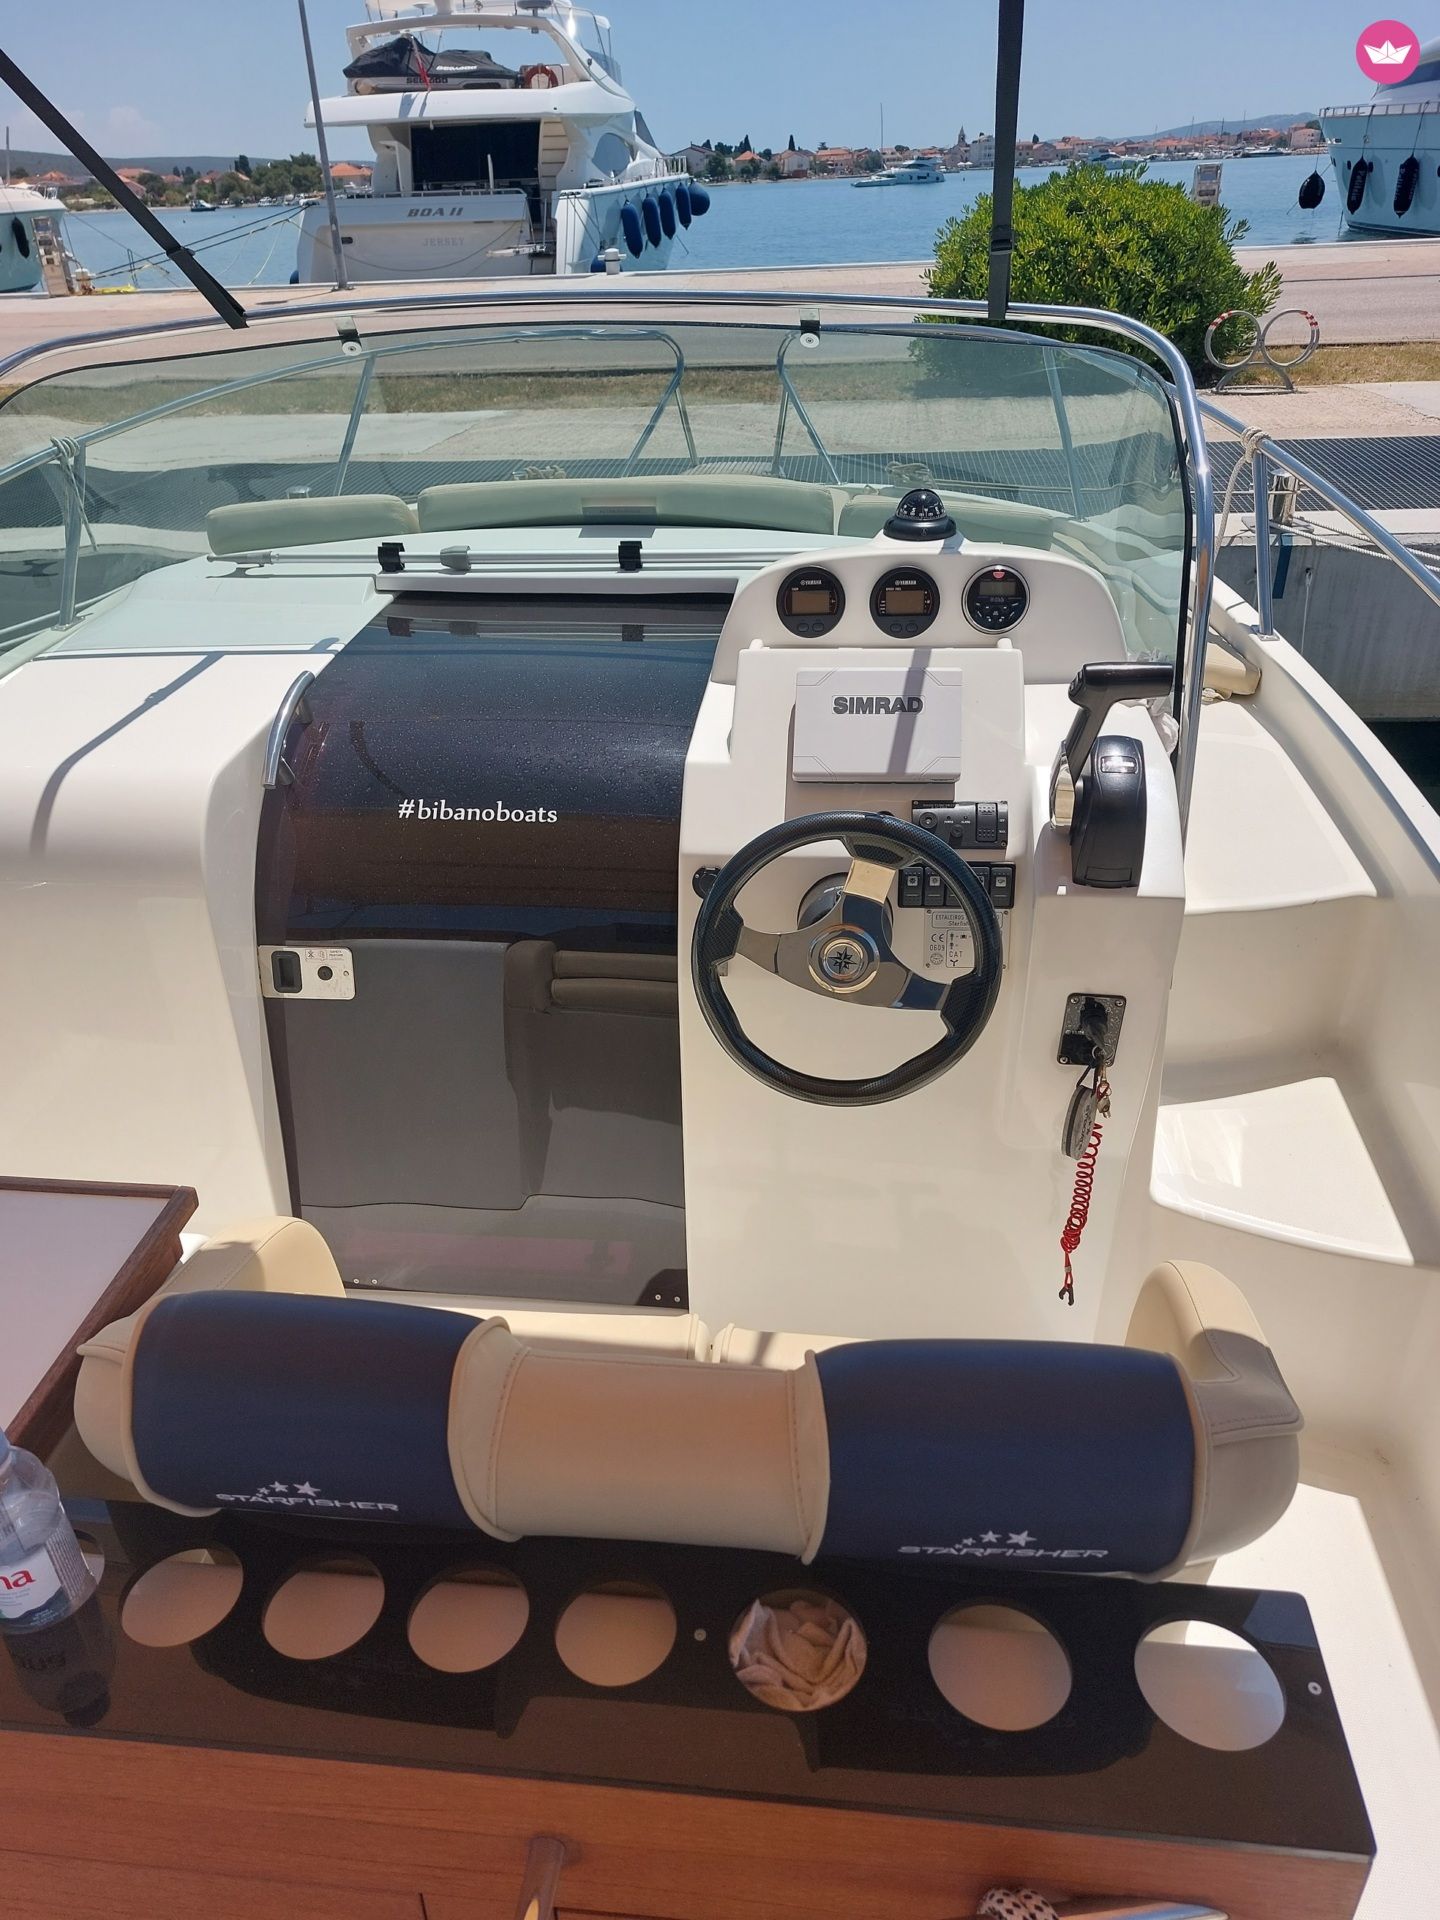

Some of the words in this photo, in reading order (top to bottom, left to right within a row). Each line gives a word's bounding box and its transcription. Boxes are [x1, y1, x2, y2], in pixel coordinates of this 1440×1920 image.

[407, 207, 444, 217] BOA
[423, 236, 465, 247] JERSEY
[832, 696, 924, 715] SIMRAD
[398, 799, 558, 823] #bibanoboats
[215, 1493, 400, 1512] STARFISHER
[898, 1545, 1109, 1558] STARFISHER
